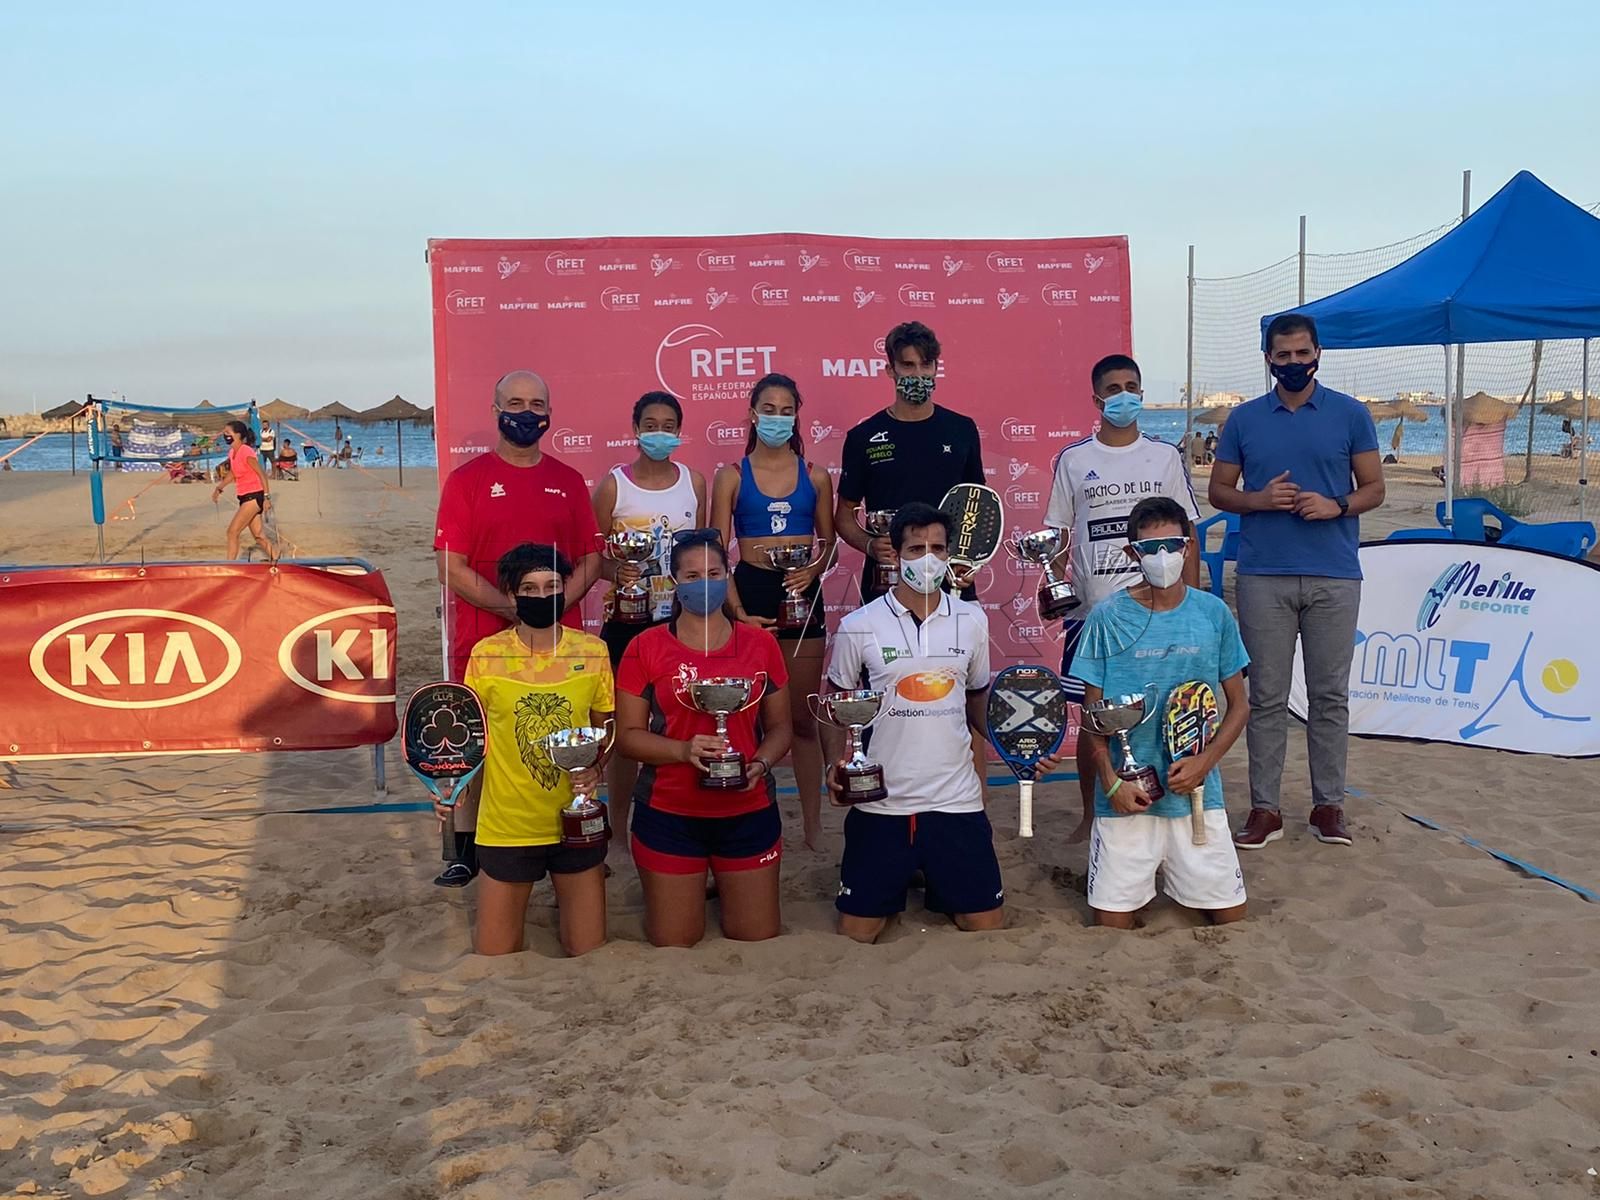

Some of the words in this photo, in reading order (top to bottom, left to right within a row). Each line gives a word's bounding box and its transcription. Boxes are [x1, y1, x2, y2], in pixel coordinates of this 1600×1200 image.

[556, 258, 586, 269] RFET
[707, 255, 736, 265] RFET
[748, 259, 785, 267] MAPFRE
[853, 255, 881, 265] RFET
[996, 257, 1024, 267] RFET
[443, 265, 484, 273] MAPFRE
[598, 263, 638, 271] MAPFRE
[894, 262, 931, 270] MAPFRE
[611, 293, 641, 304] RFET
[761, 289, 789, 299] RFET
[908, 290, 936, 300] RFET
[1051, 289, 1078, 300] RFET
[456, 297, 486, 307] RFET
[499, 302, 540, 310] MAPFRE
[547, 301, 587, 309] MAPFRE
[653, 298, 693, 306] MAPFRE
[948, 297, 984, 305] MAPFRE
[690, 346, 777, 378] RFET
[821, 358, 945, 378] MAPE
[692, 383, 714, 392] REAL
[692, 390, 738, 401] ESPAÑOLA
[717, 428, 746, 438] RFET
[1011, 425, 1036, 435] RFET
[1048, 430, 1081, 438] MAPFRE
[563, 435, 593, 446] RFET
[450, 446, 489, 454] MAPFRE
[1124, 482, 1136, 494] DE
[1140, 481, 1151, 493] LA
[1014, 492, 1040, 502] RFET
[1459, 600, 1530, 615] DEPORTE
[1018, 626, 1044, 637] RFET
[66, 631, 207, 686] KIA
[1383, 691, 1431, 704] Melillense
[1435, 696, 1448, 706] de
[1453, 697, 1480, 710] Tenis
